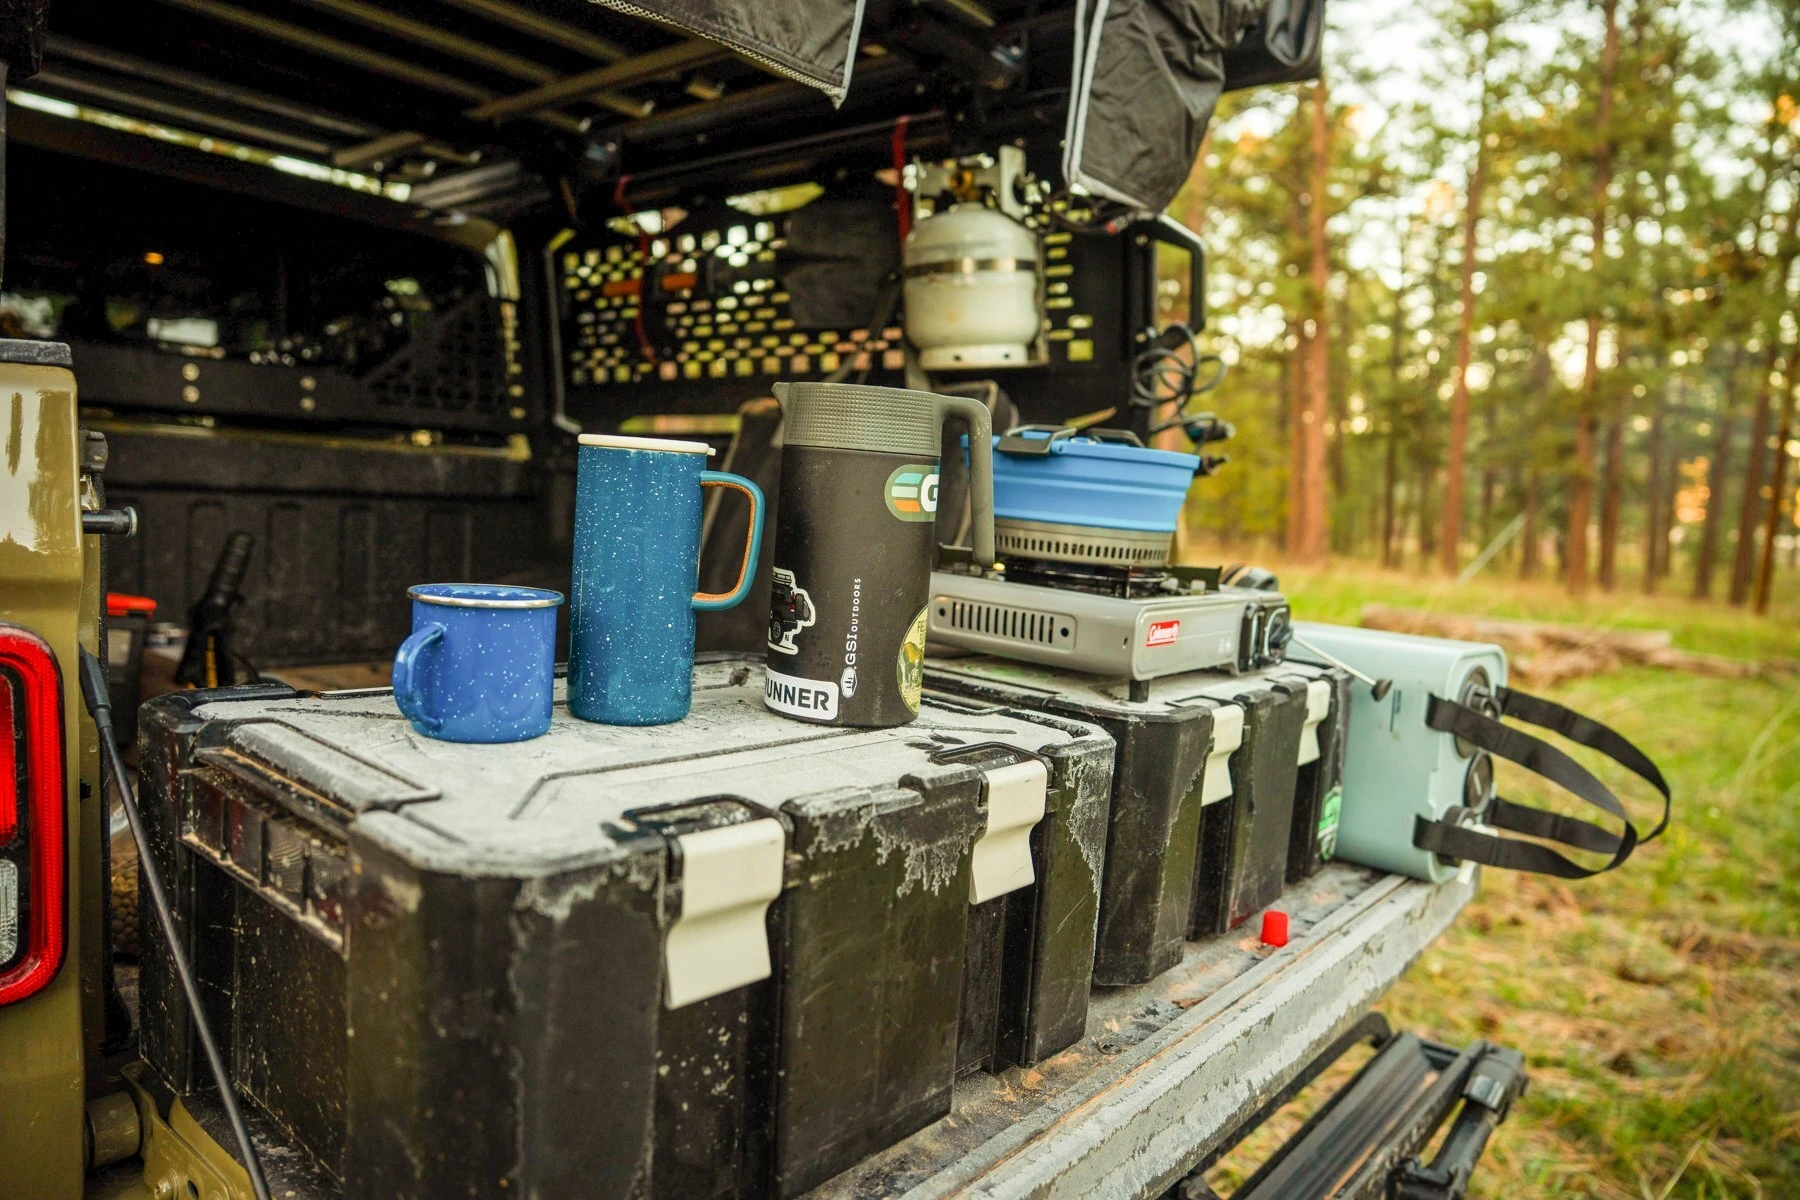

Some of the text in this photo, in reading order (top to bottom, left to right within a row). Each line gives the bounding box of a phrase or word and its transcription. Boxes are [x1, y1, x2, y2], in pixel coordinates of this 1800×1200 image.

[921, 474, 939, 512] G
[845, 578, 861, 665] GSI OUTDOORS
